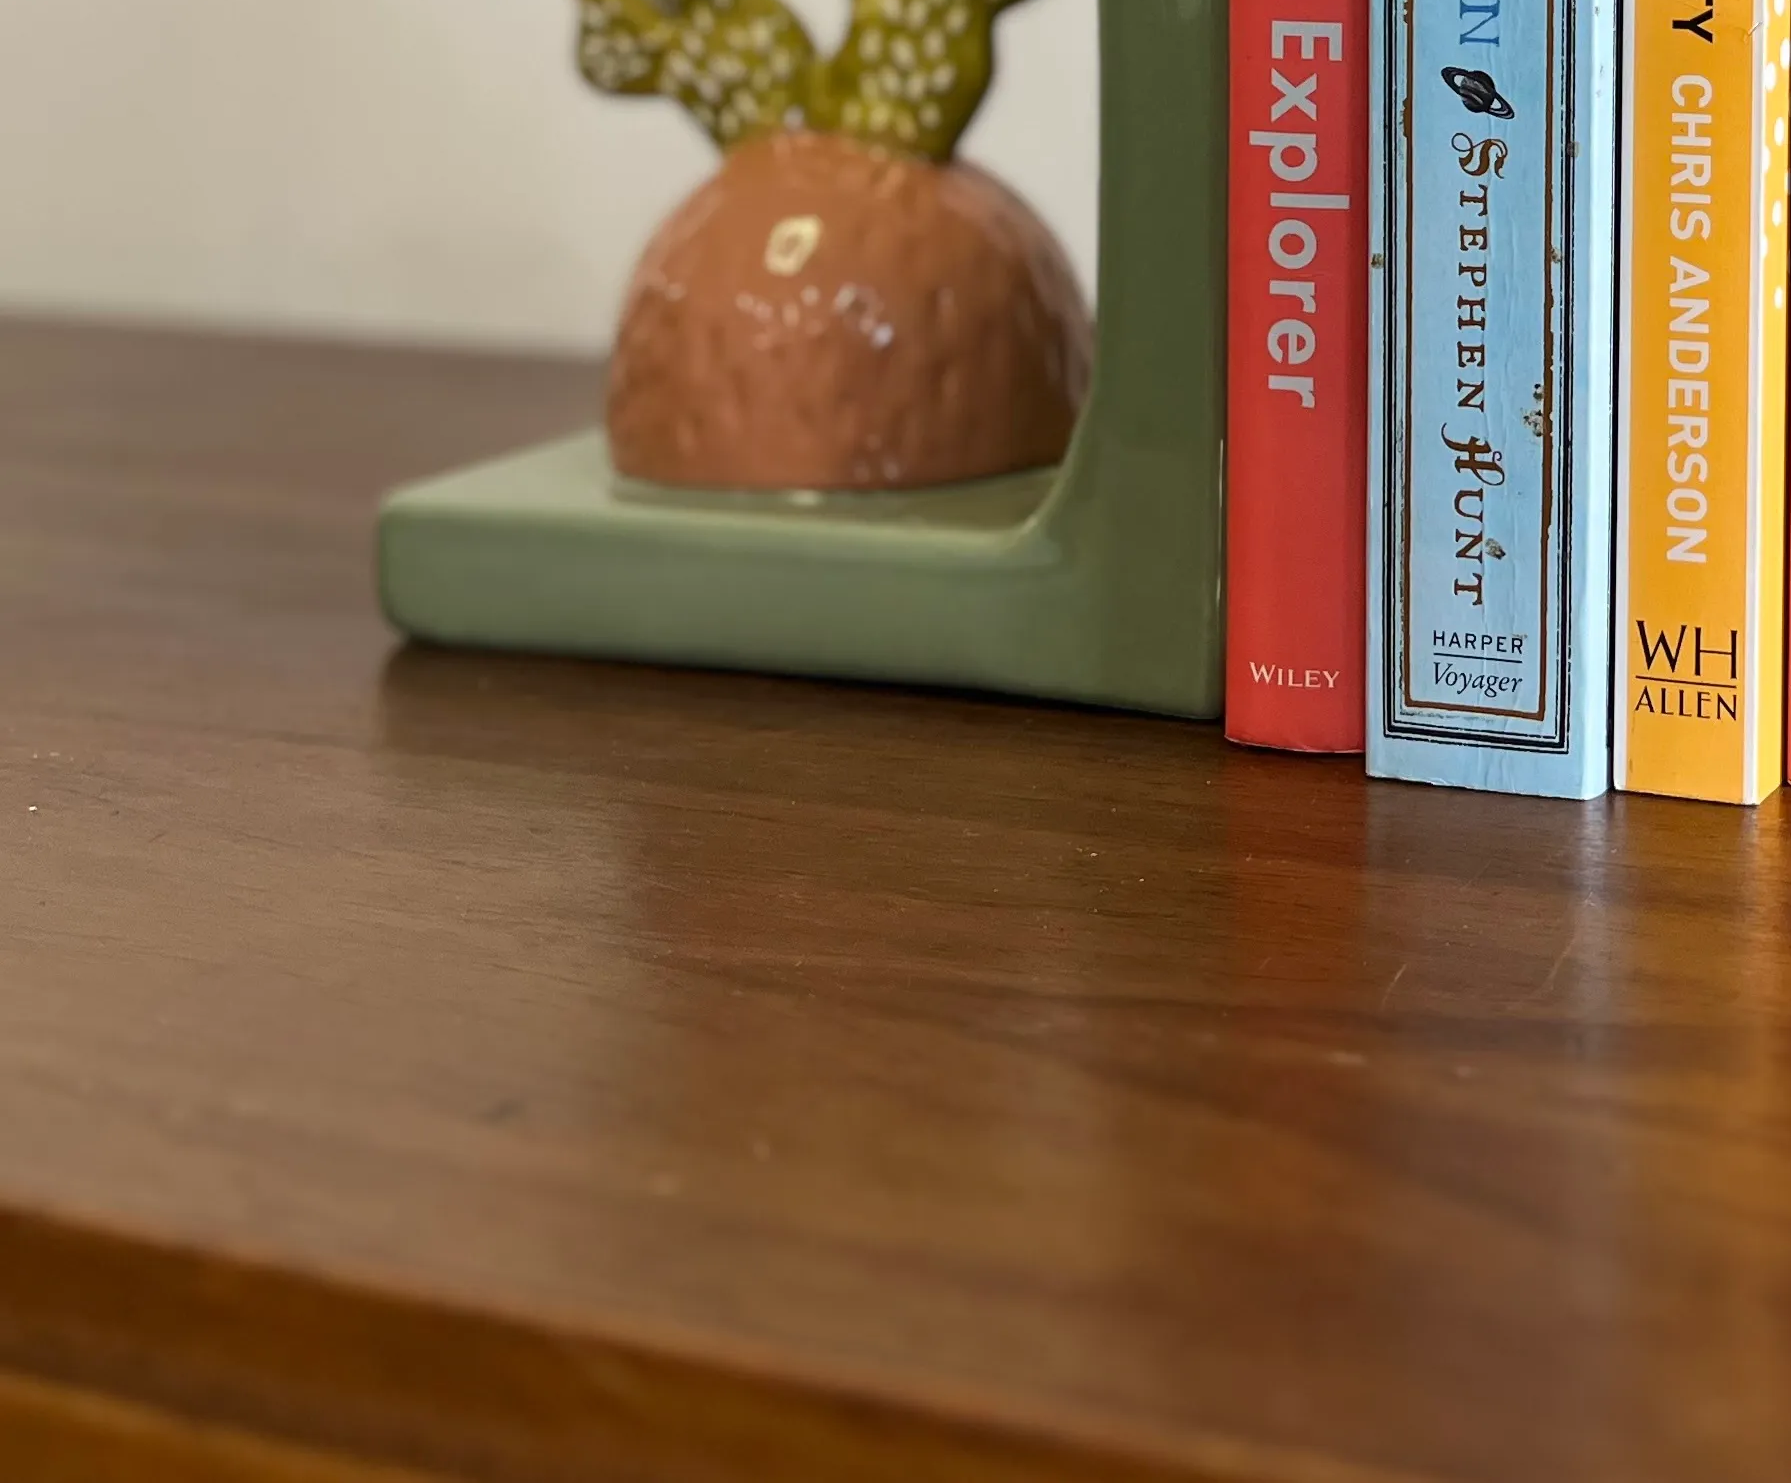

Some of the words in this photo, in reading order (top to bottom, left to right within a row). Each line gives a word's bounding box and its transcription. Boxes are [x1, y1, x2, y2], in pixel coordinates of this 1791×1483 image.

[1249, 20, 1351, 409] Explorer
[1669, 74, 1713, 241] CHRIS
[1451, 132, 1509, 412] STEPHEN
[1666, 256, 1710, 564] ANDERSON
[1441, 421, 1505, 606] HUNT
[1249, 661, 1340, 690] WILEY
[1432, 628, 1524, 655] HARPER
[1432, 660, 1524, 698] Voyager
[1636, 619, 1738, 680] WH
[1634, 687, 1738, 722] ALLEN
